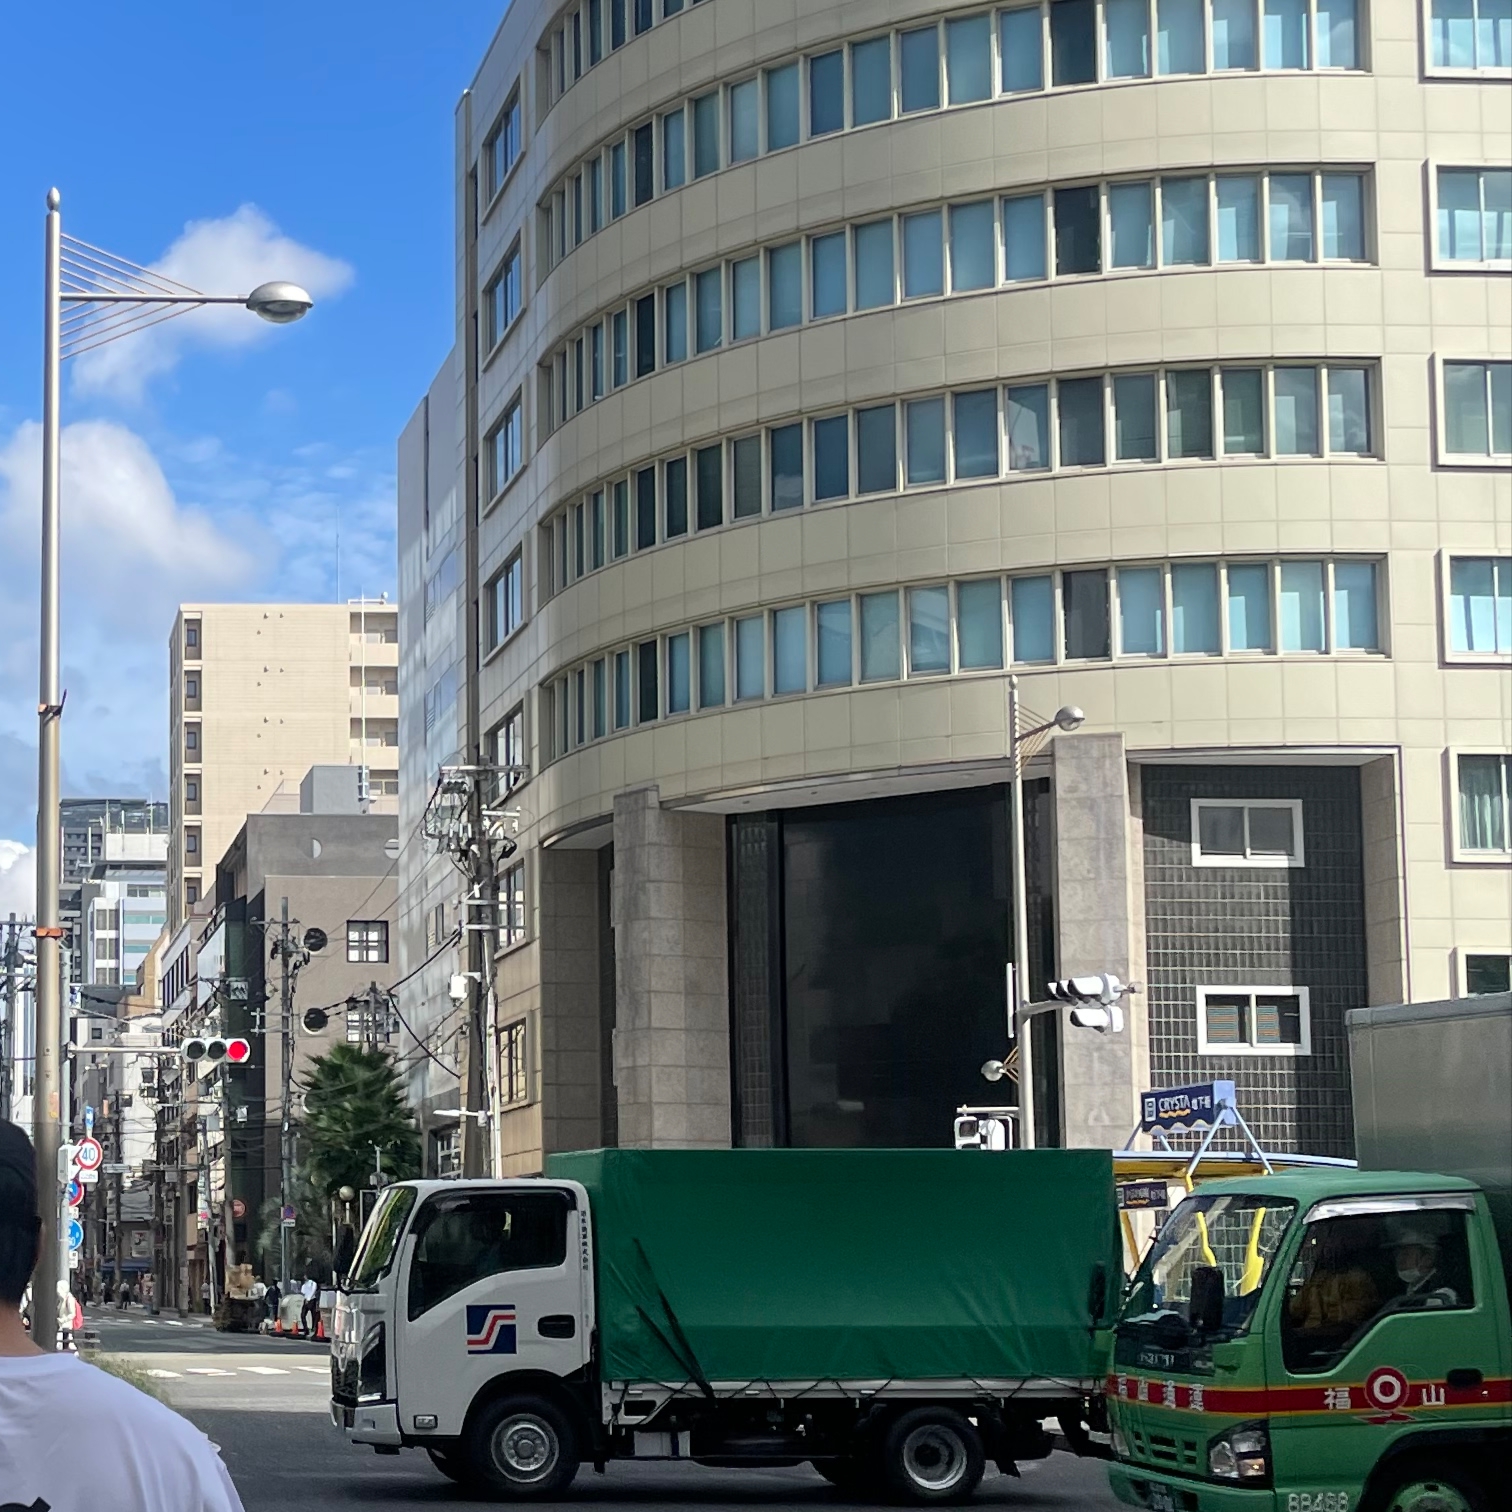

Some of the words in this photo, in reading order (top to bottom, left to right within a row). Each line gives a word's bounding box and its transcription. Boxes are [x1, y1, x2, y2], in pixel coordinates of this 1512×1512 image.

[1158, 1095, 1190, 1112] CRYSTA
[81, 1147, 96, 1161] 40
[1324, 1386, 1351, 1410] 福
[1421, 1384, 1446, 1406] 山
